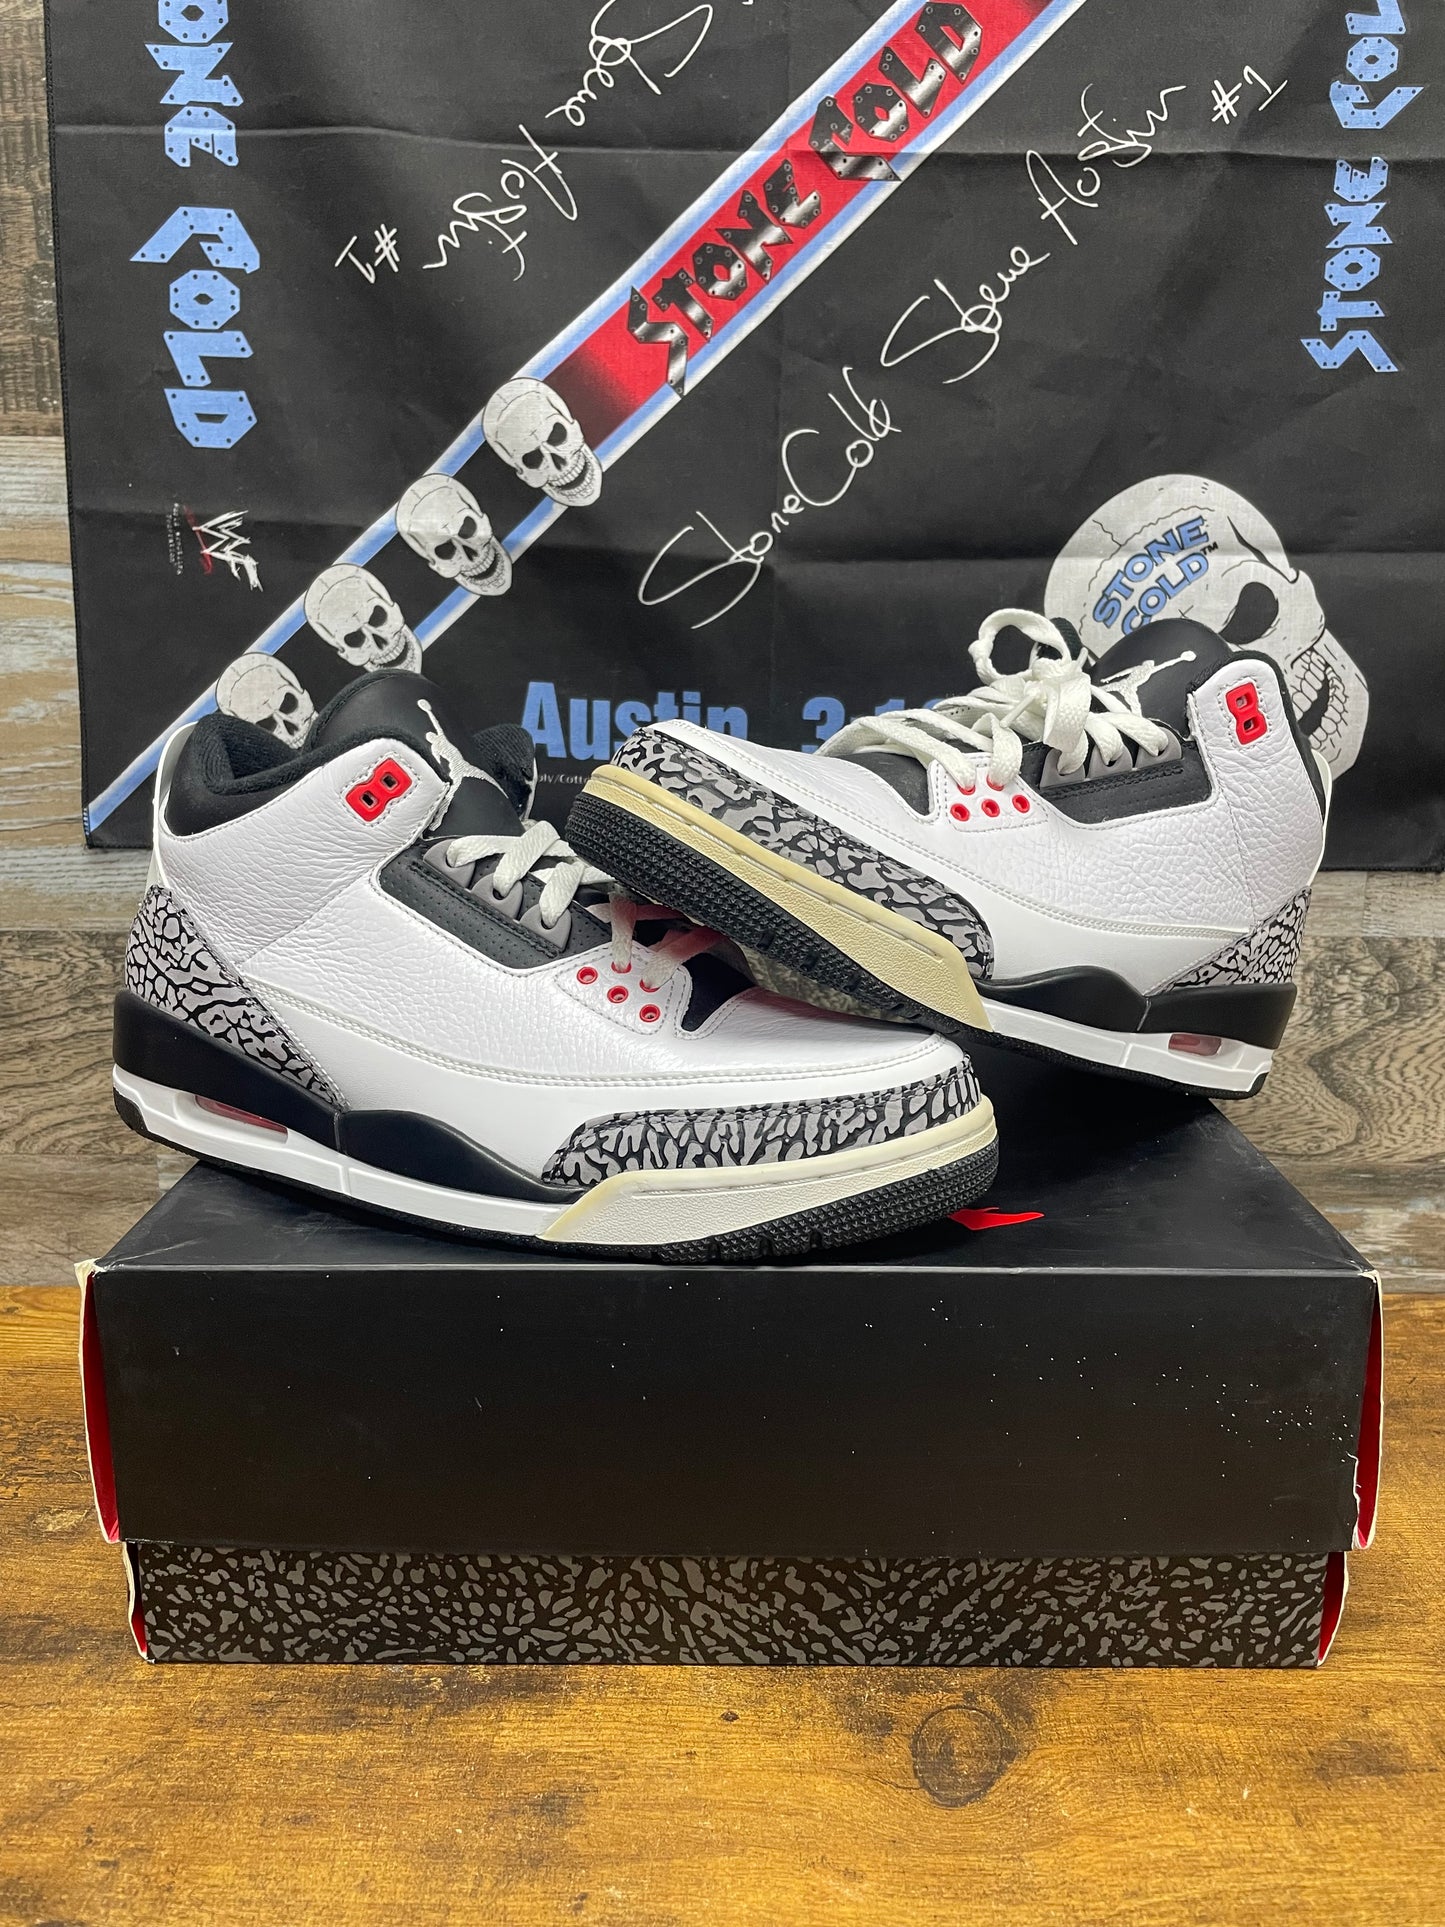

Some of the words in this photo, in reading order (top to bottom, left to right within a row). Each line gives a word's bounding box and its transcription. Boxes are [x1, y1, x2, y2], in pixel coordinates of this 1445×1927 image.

[627, 158, 821, 397] STONE
[808, 1, 982, 181] COLD
[1211, 65, 1288, 125] #1
[130, 206, 260, 449] COLD
[1300, 156, 1399, 373] STONE
[1092, 516, 1209, 628] STONE
